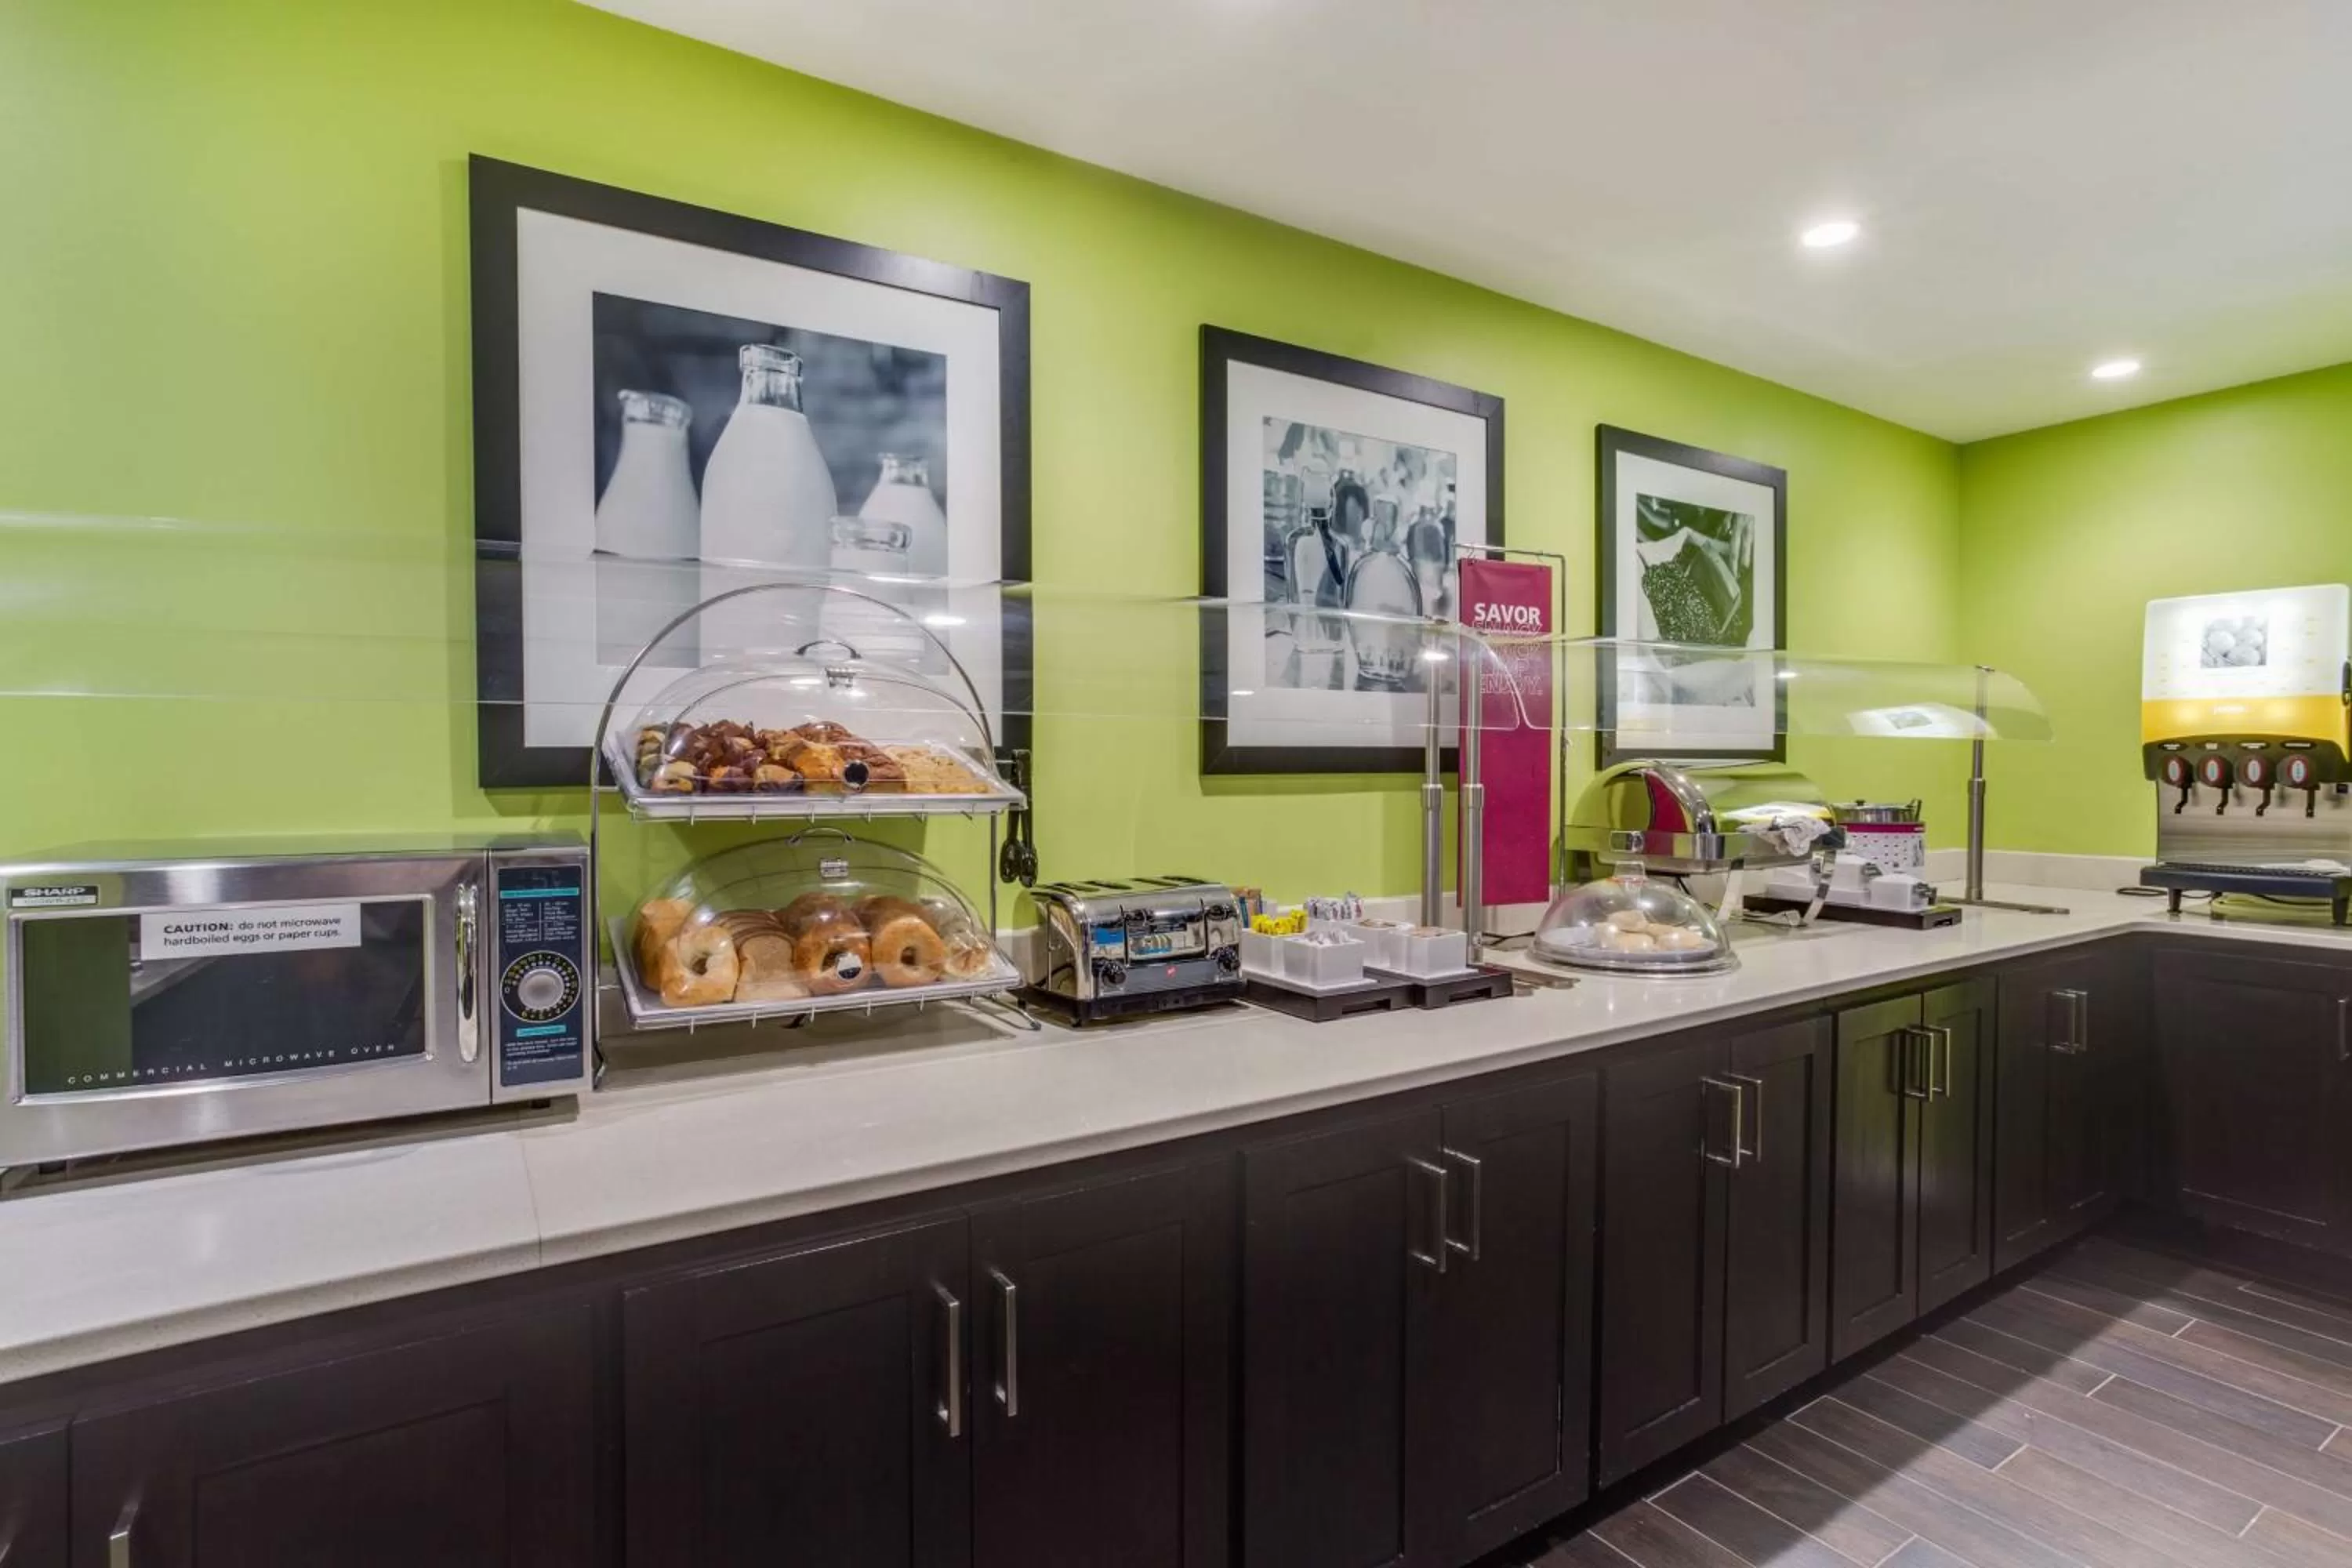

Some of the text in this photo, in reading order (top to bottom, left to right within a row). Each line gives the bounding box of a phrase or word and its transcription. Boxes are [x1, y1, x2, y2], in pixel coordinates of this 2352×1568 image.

[1474, 602, 1541, 626] SAVOR
[24, 887, 85, 897] SHARP
[164, 918, 341, 934] CAUTION: do not microwave
[164, 933, 230, 946] hardboiled
[233, 933, 260, 943] eggs
[278, 930, 312, 941] paper
[67, 1044, 394, 1084] COMMERCIAL MICROWAVE OVEN
